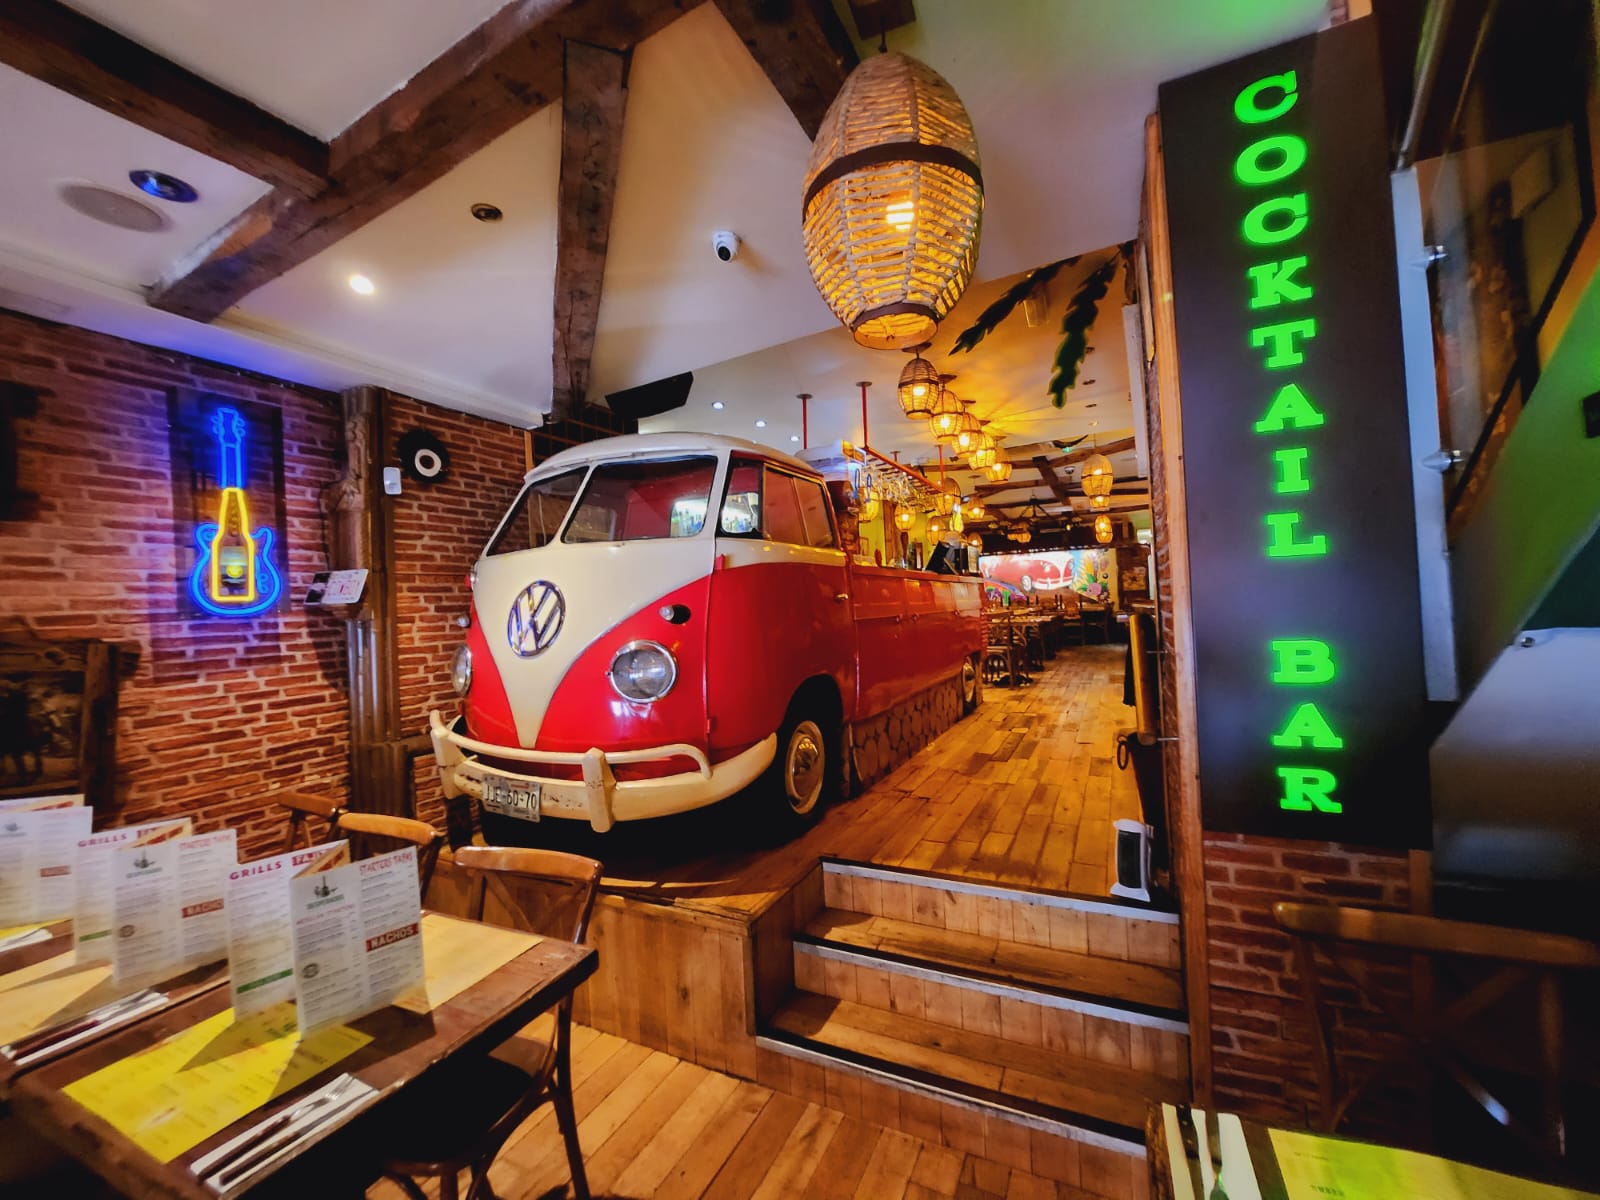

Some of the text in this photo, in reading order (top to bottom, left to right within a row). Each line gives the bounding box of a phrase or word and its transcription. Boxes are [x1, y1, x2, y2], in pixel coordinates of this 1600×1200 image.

[1233, 69, 1344, 814] COCKTAIL BAR
[229, 861, 282, 880] GRILLS
[370, 925, 414, 950] NACHOS
